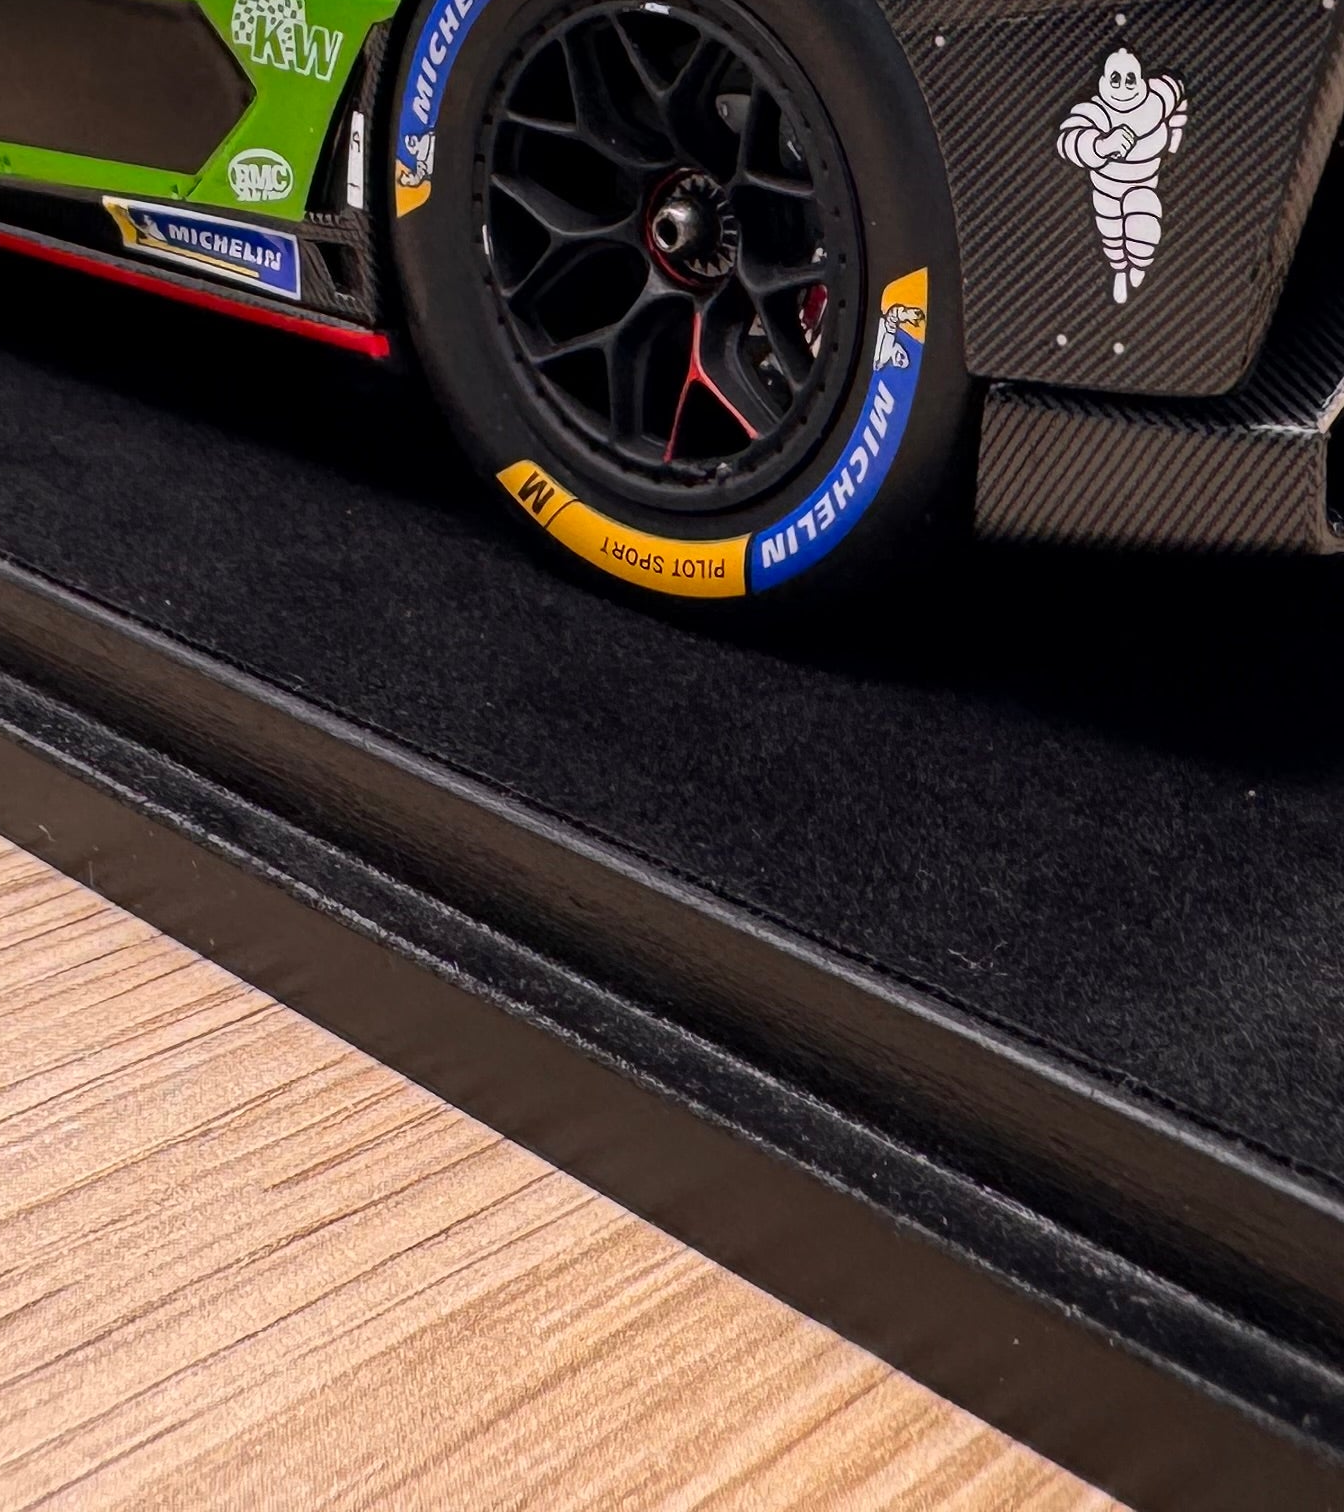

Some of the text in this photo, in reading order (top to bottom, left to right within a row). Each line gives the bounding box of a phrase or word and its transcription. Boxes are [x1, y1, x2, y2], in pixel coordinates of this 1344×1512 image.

[251, 14, 344, 83] KW
[235, 162, 290, 193] BMC
[167, 223, 283, 272] MICHELIN
[516, 471, 555, 515] M
[761, 380, 895, 569] MICHELIN
[600, 536, 725, 579] PILOT SPORT
